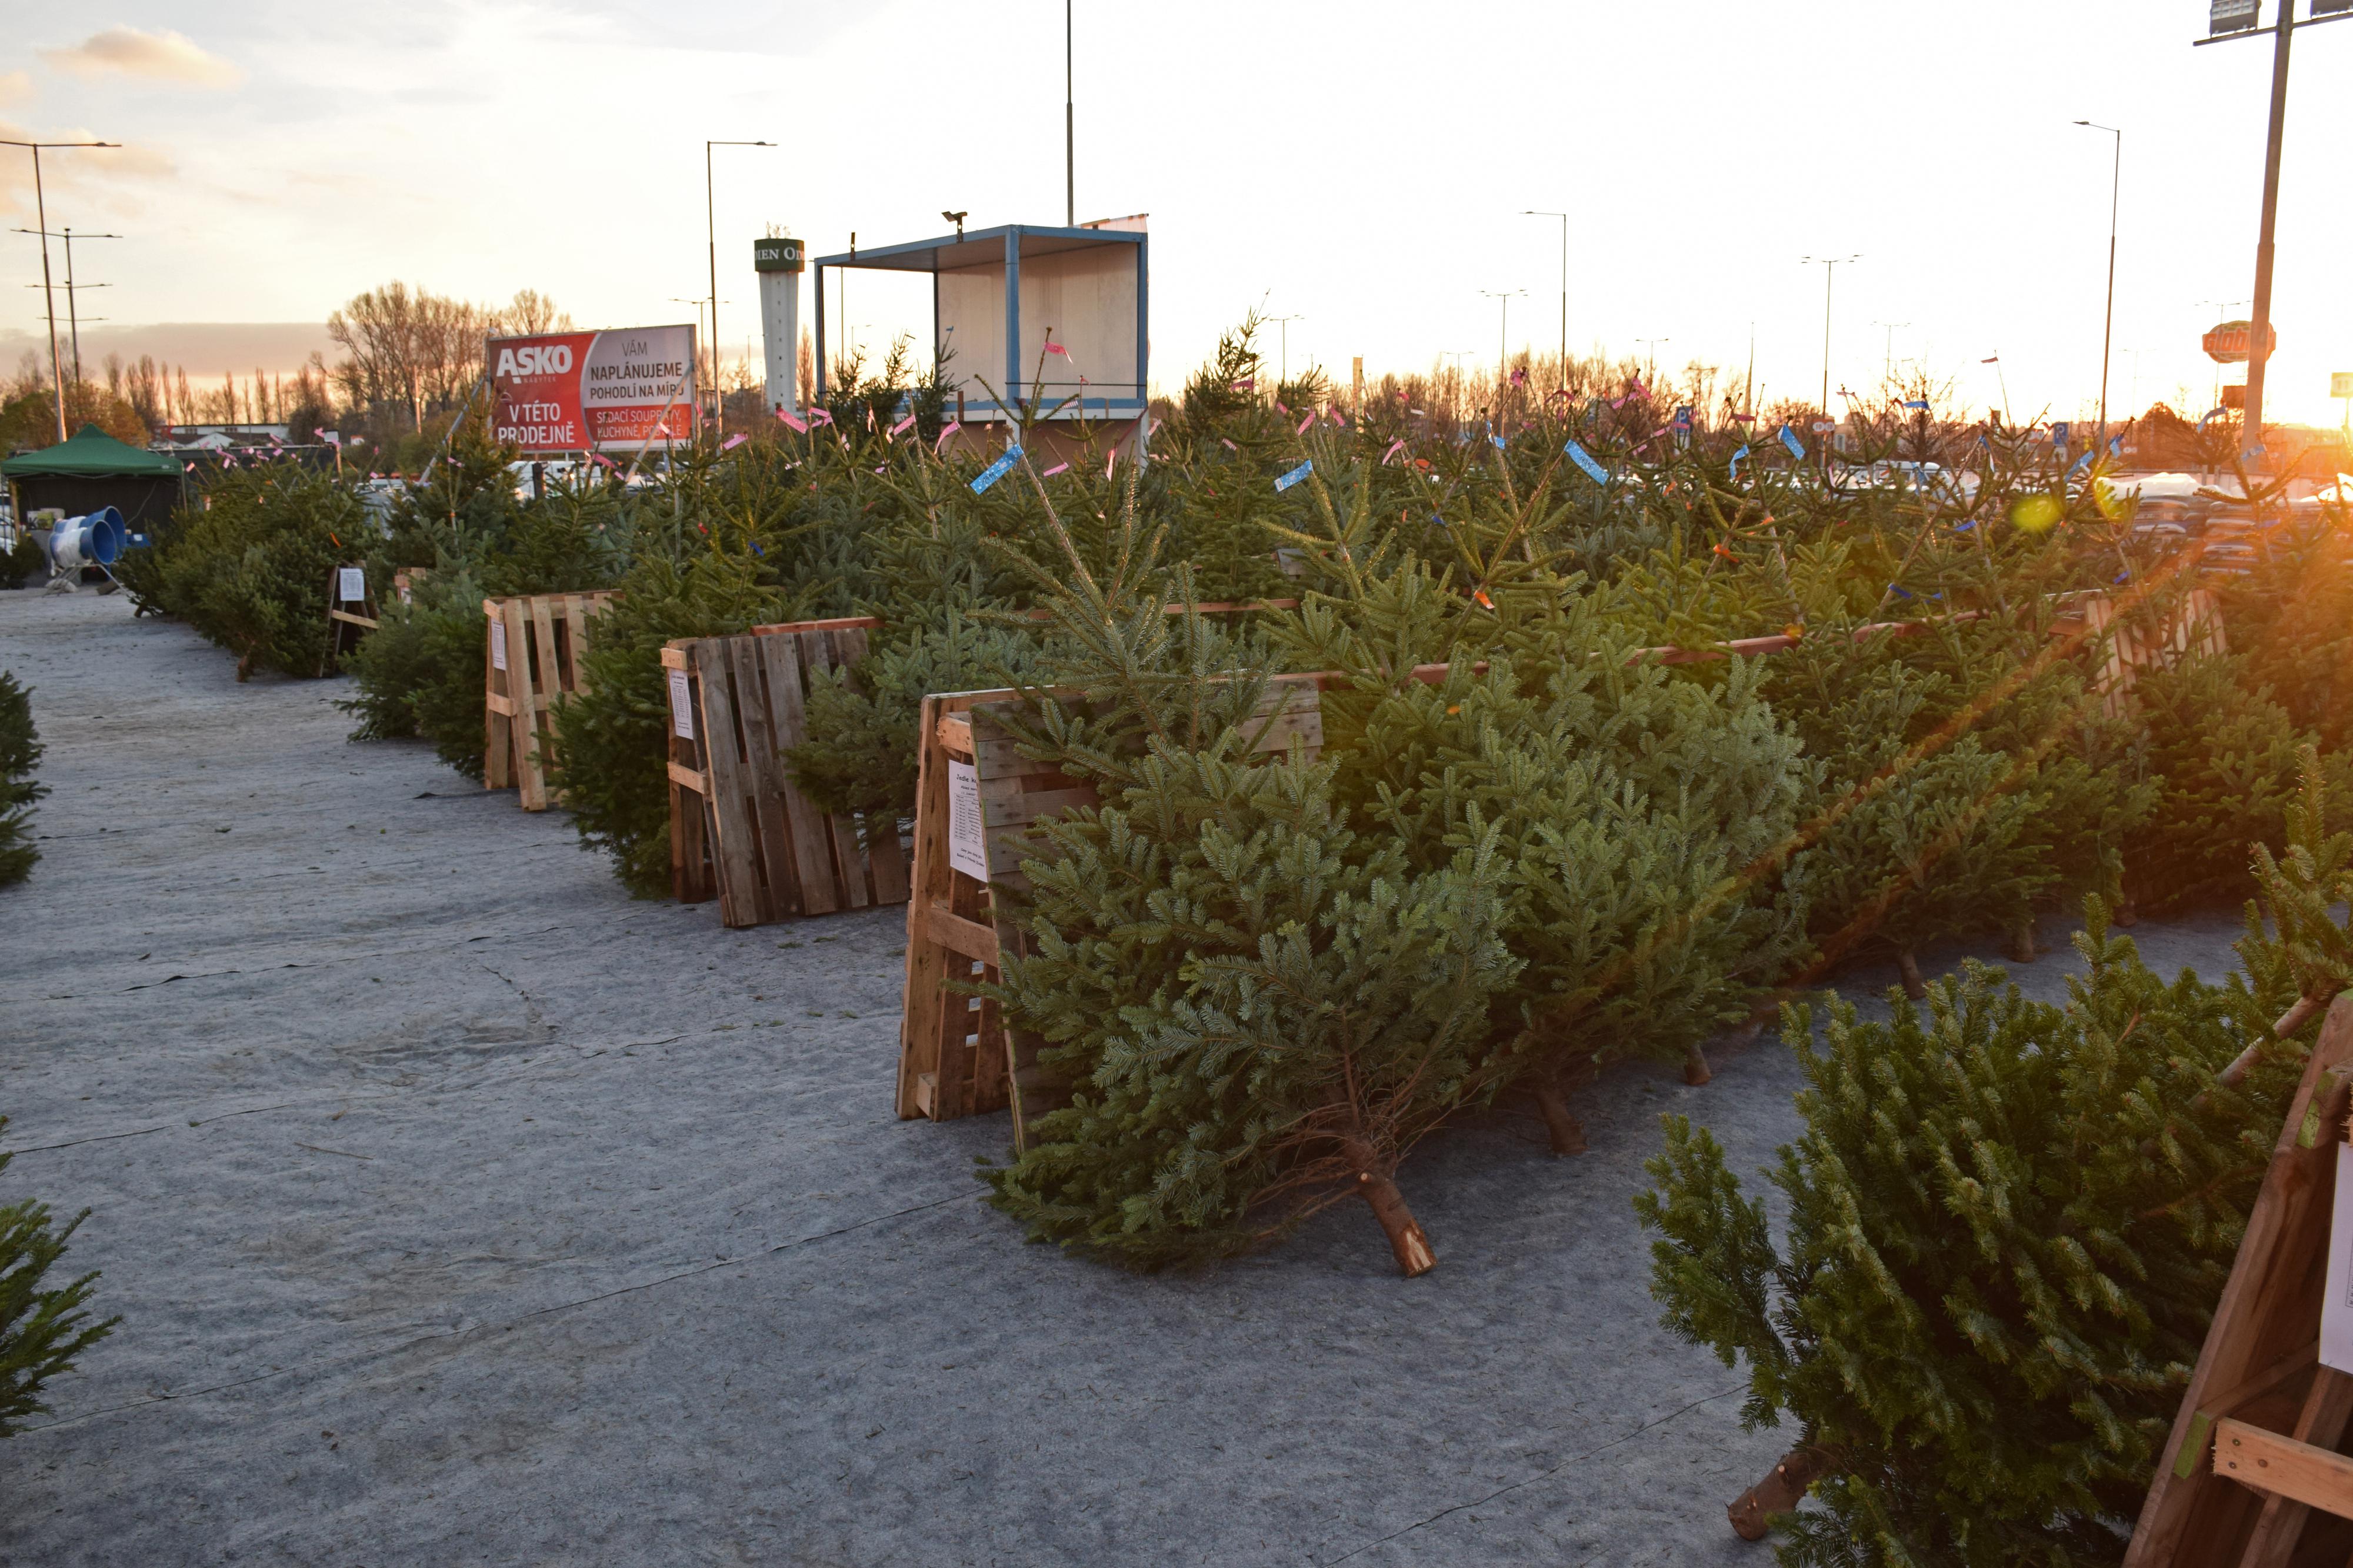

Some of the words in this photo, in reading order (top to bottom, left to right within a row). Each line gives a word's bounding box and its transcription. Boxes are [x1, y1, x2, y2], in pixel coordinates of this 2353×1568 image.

[622, 339, 647, 356] VÁM
[496, 345, 573, 383] ASKO
[591, 361, 682, 381] NAPLÁNUJEME
[590, 382, 636, 399] POHODLÍ
[639, 386, 654, 398] NA
[509, 404, 519, 422] V
[522, 400, 561, 422] TÉTO
[596, 409, 628, 424] SEDACÍ
[498, 421, 575, 445] PRODEJNĚ
[956, 774, 969, 782] Jedle
